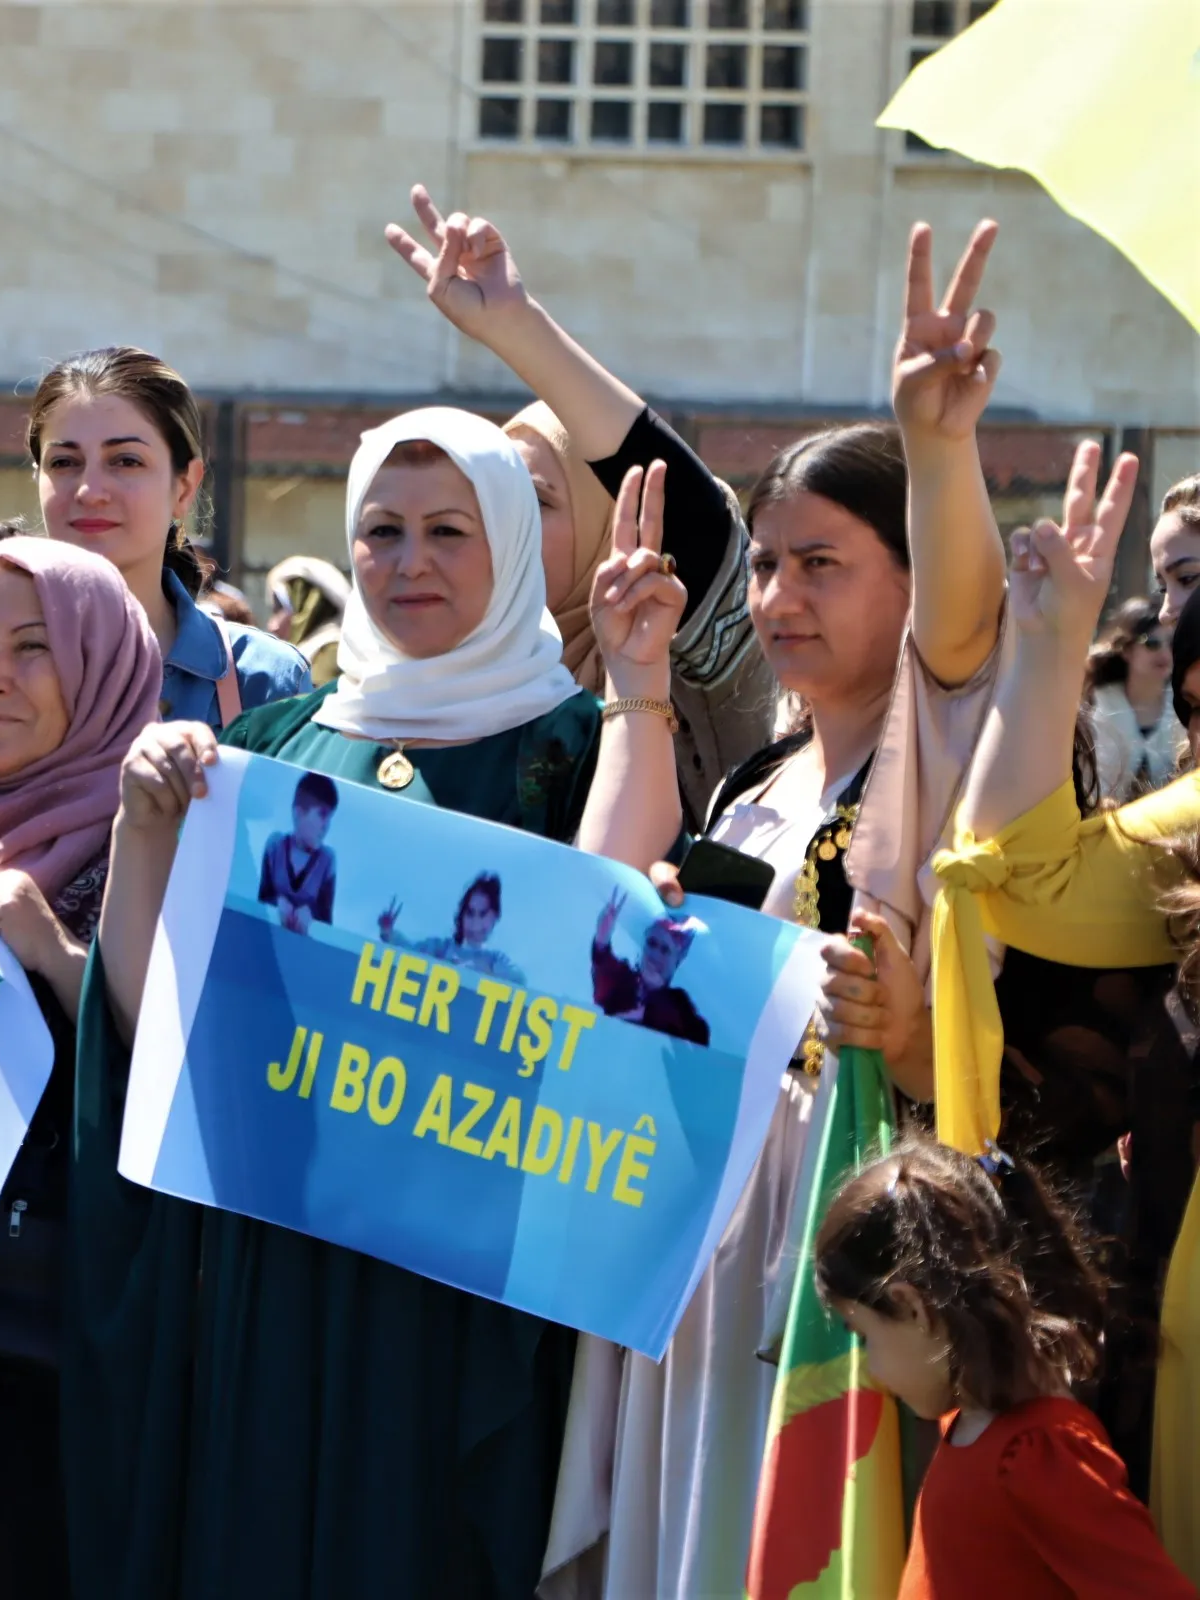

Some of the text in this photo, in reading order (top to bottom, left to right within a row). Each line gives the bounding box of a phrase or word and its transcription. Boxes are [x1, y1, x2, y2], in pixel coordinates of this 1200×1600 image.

[350, 942, 597, 1078] HER TIŞT
[266, 1026, 658, 1208] JI BO AZADIYÊ
